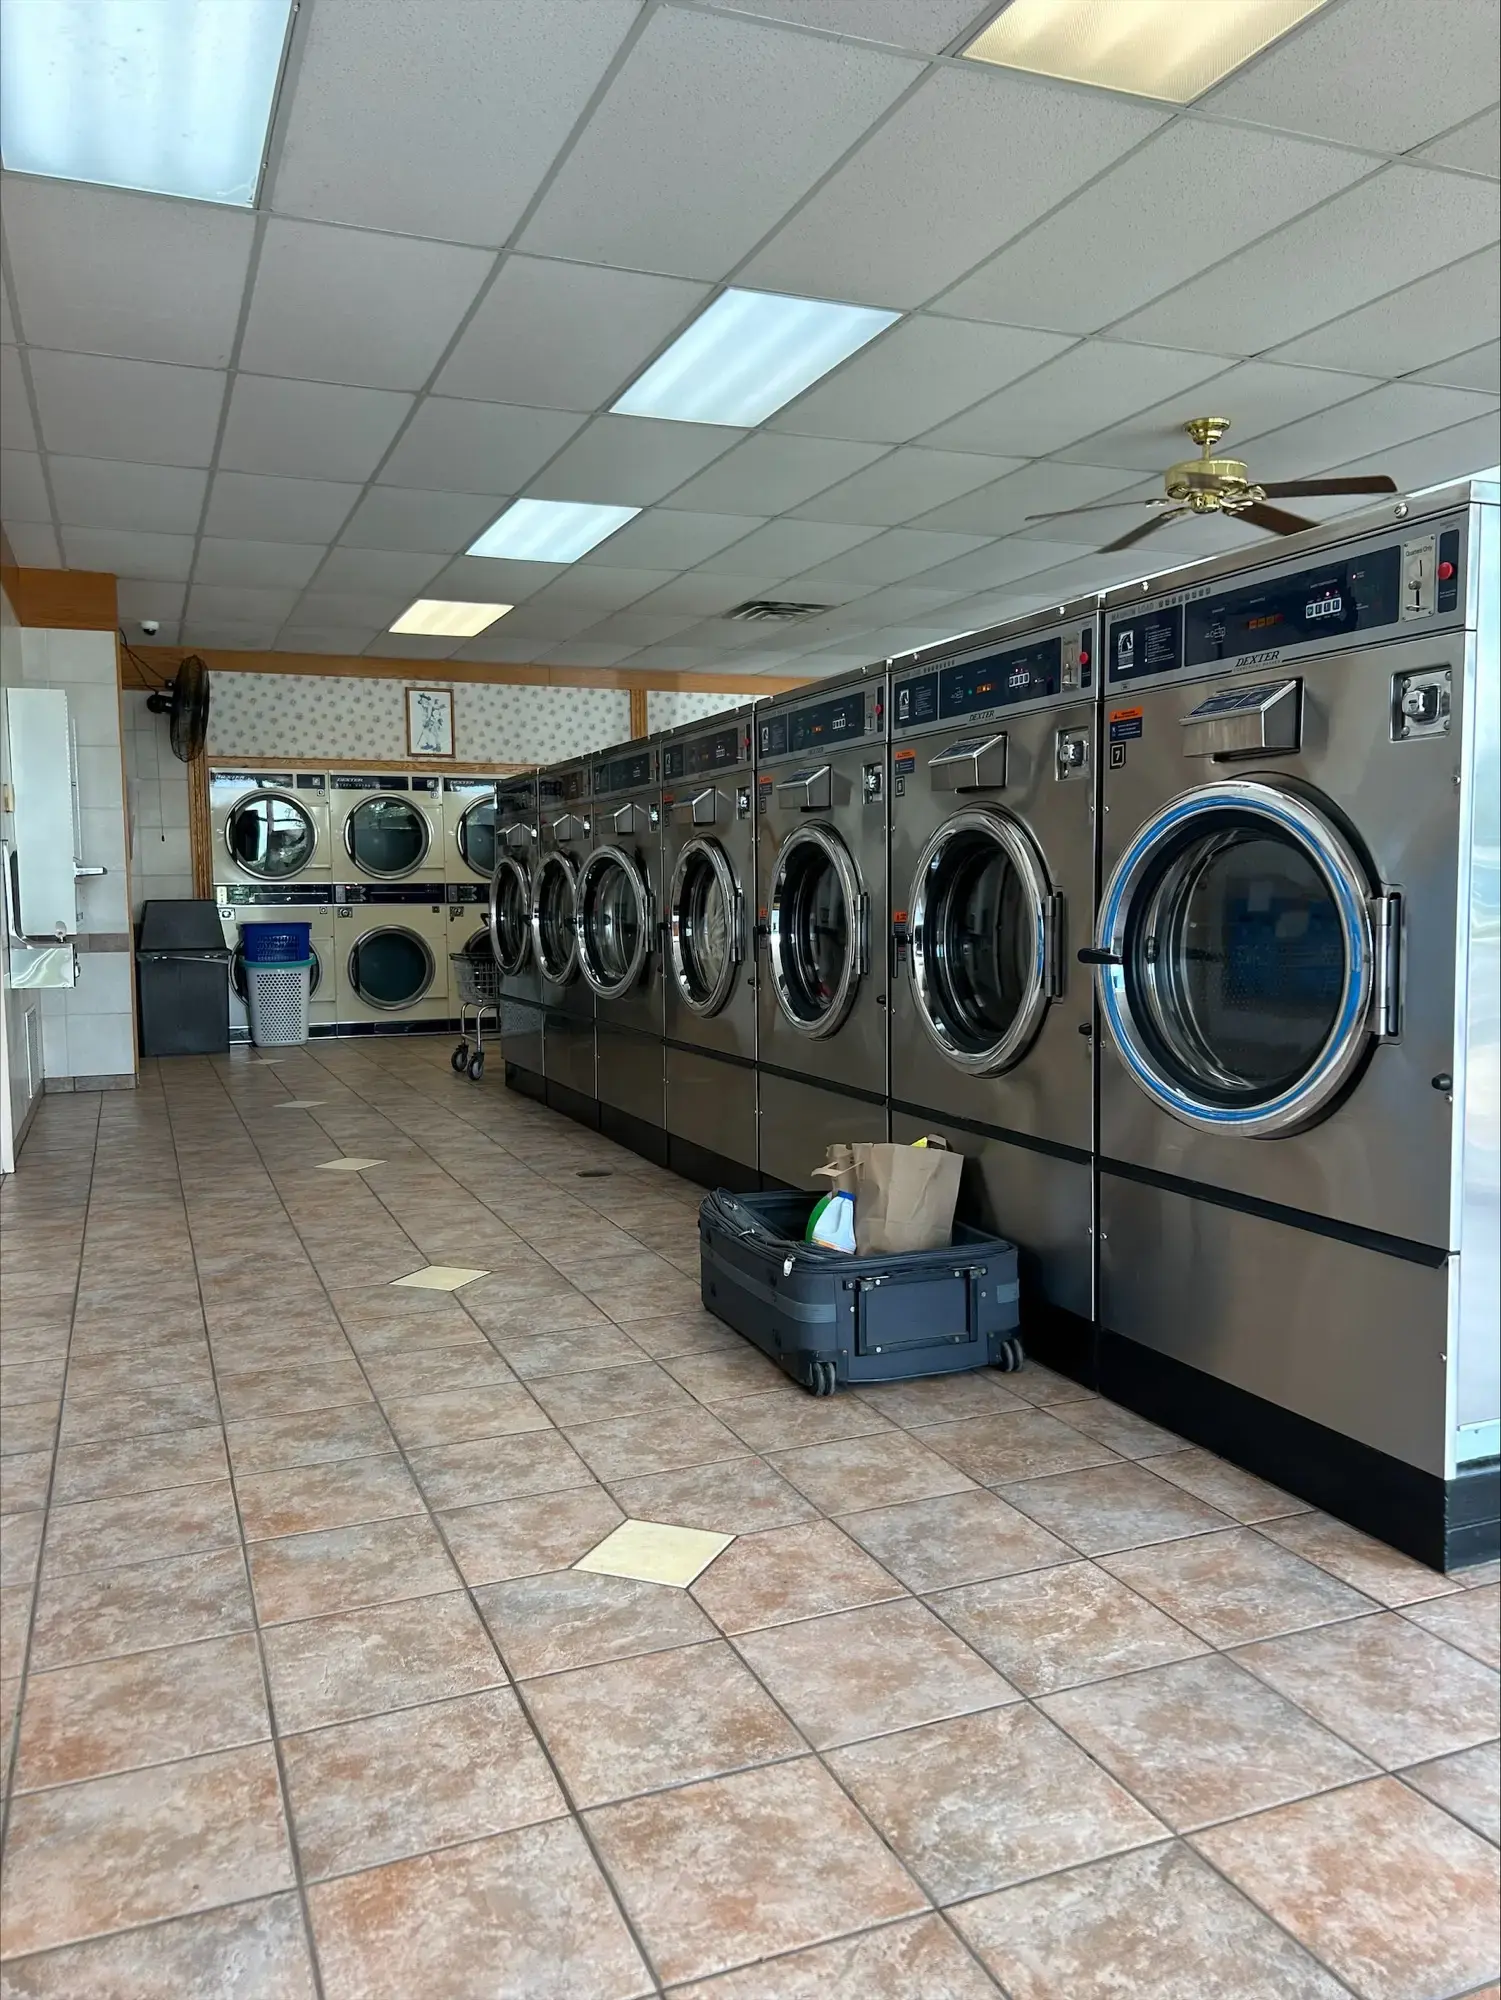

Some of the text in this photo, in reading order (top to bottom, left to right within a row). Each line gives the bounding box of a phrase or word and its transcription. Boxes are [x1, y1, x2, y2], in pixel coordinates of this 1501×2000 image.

[1235, 650, 1280, 667] DEXTER
[969, 710, 995, 722] DEXTER
[1115, 750, 1121, 761] 7
